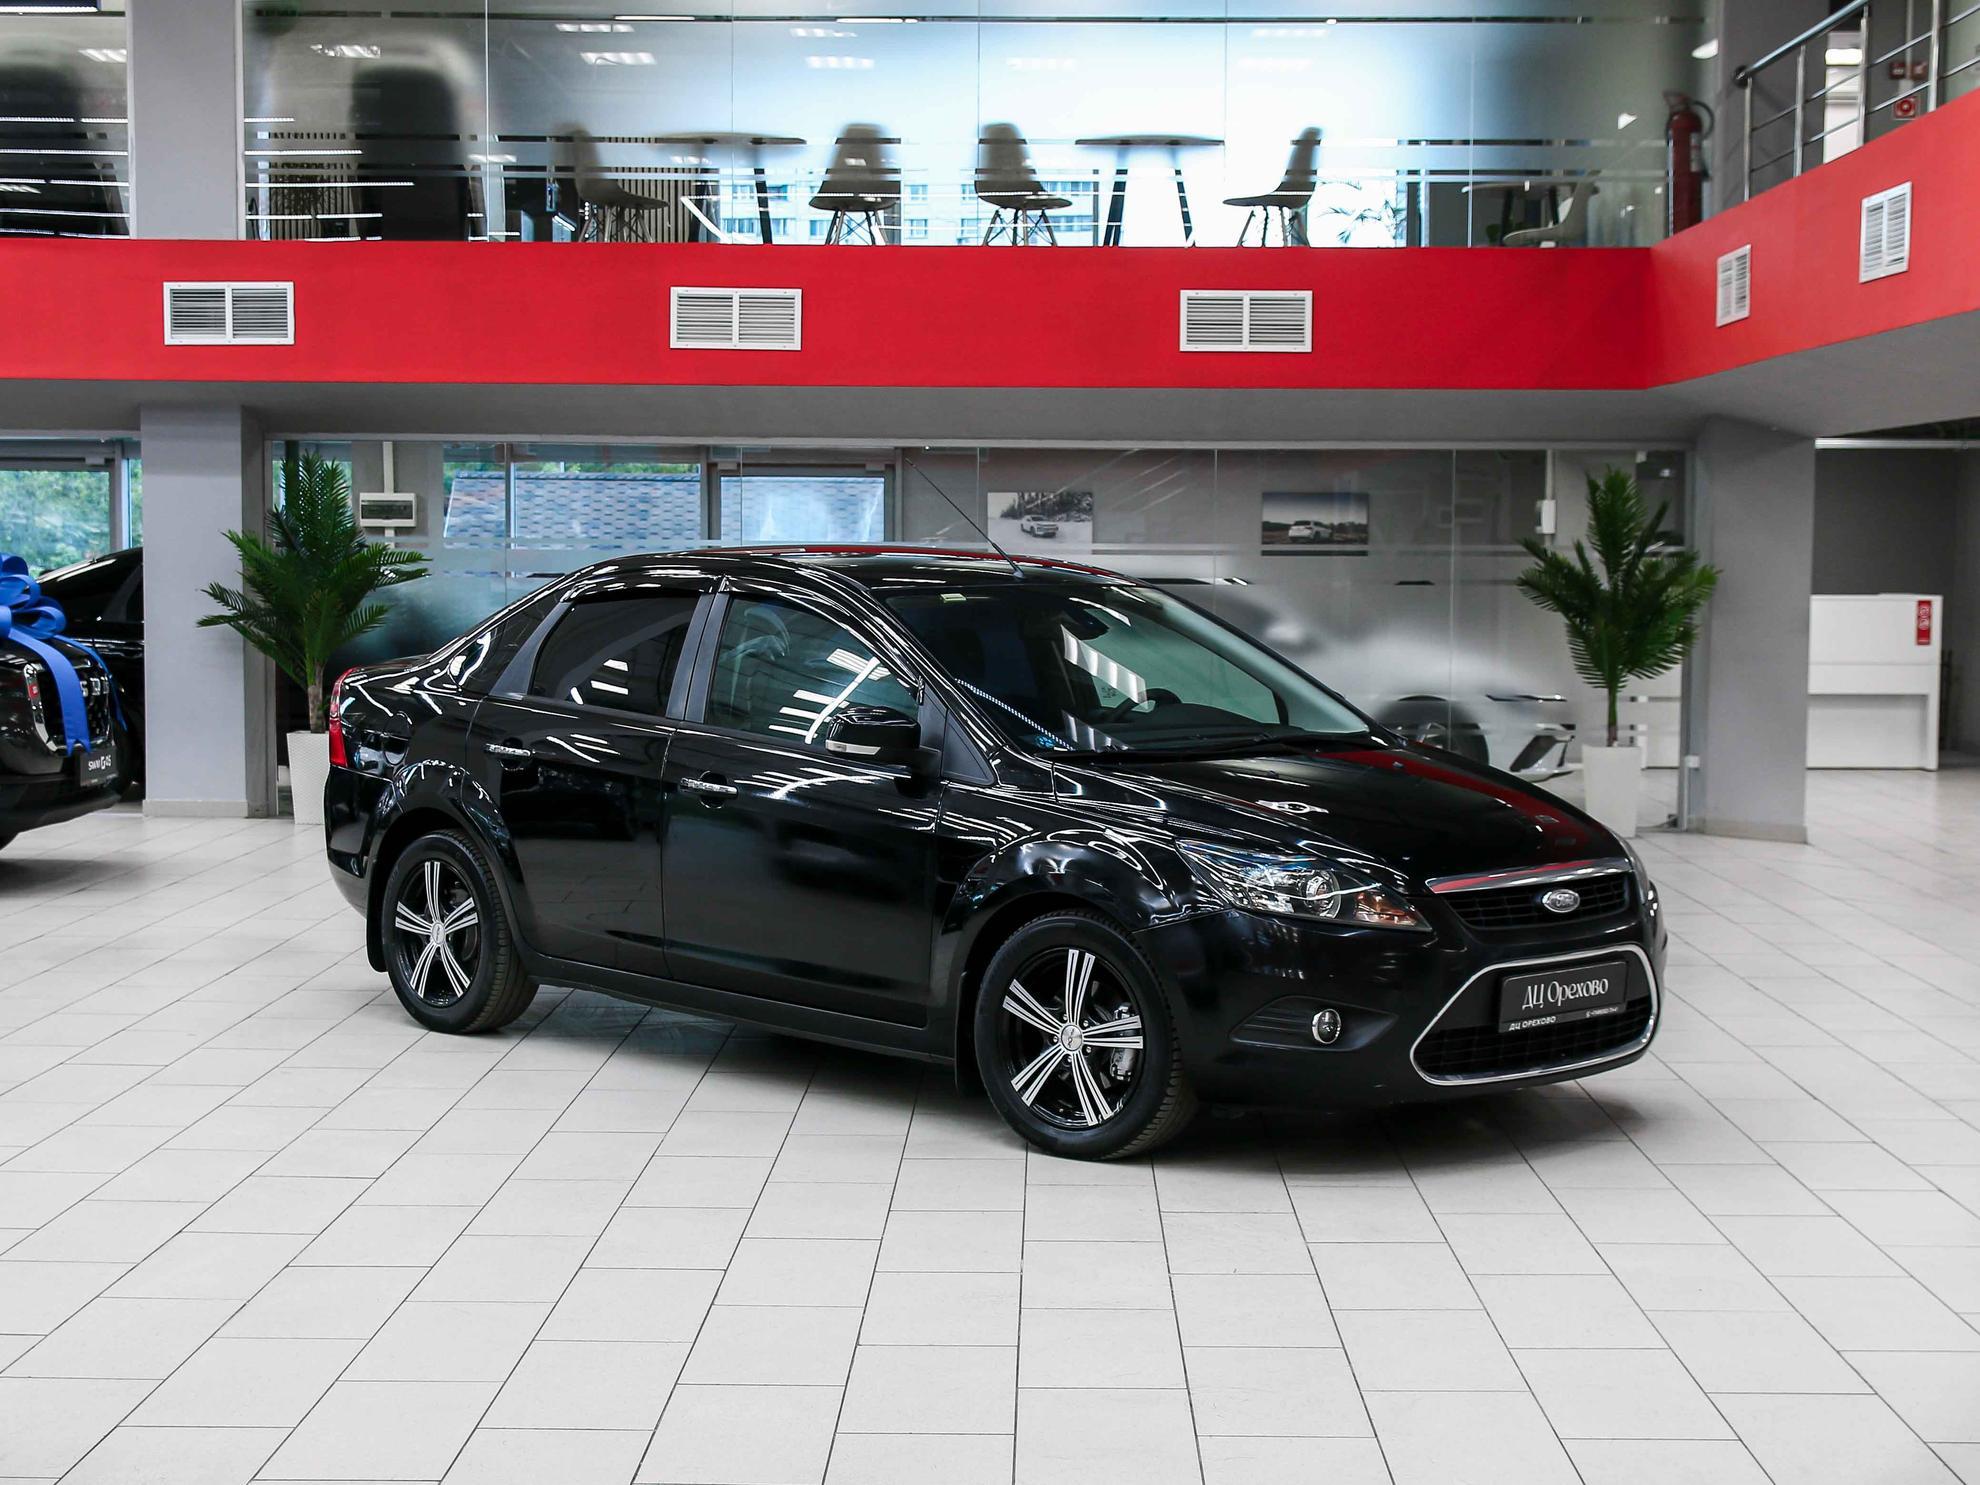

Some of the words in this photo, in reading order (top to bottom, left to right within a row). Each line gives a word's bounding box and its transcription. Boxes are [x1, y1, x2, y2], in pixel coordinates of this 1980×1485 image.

[1522, 984, 1544, 1010] ДЦ
[1547, 978, 1609, 1006] Орехово
[1508, 1022, 1521, 1031] ДЦ
[1522, 1016, 1557, 1028] ОРЕХОВО
